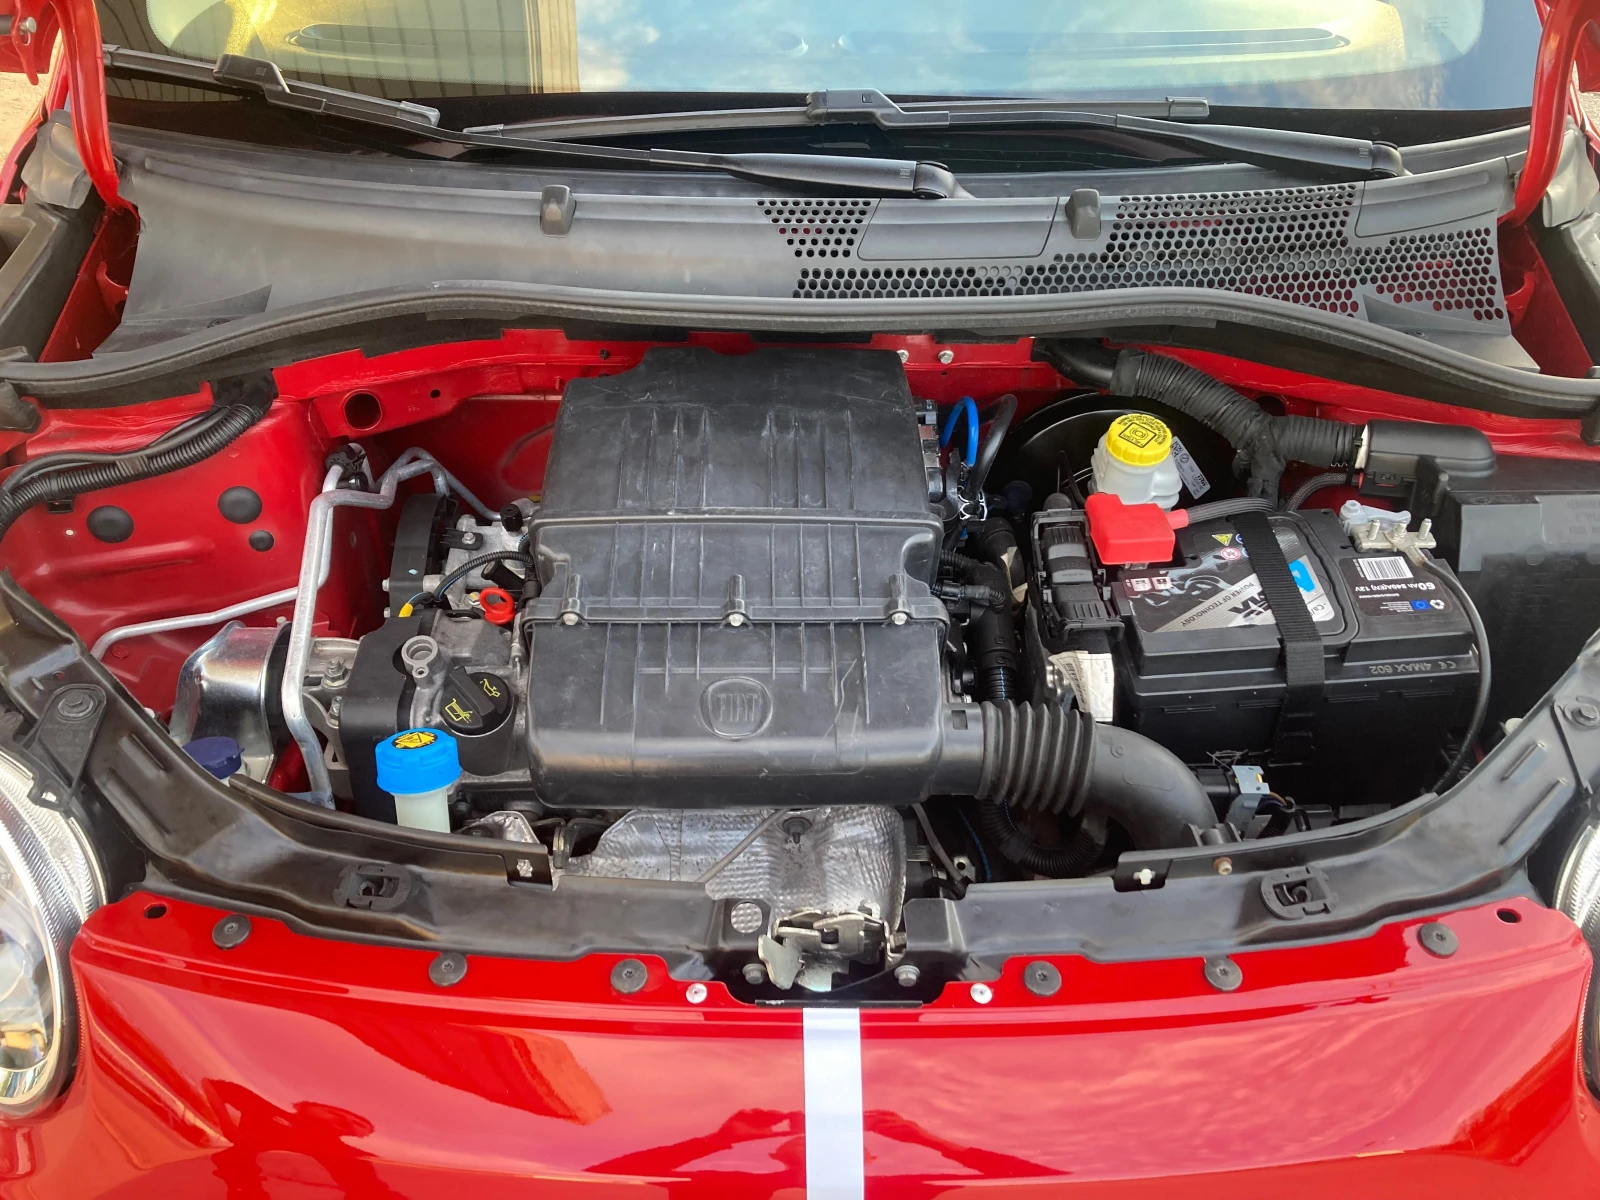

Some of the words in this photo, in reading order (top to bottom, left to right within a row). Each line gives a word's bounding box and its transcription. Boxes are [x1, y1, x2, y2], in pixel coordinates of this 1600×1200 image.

[1230, 582, 1253, 599] POWER
[1407, 581, 1436, 591] 60Ah
[1221, 594, 1230, 602] OF
[1180, 599, 1222, 626] TECHNOLOGY
[1368, 665, 1393, 674] 602
[1394, 662, 1432, 672] 4MAX
[717, 694, 758, 722] FIAT
